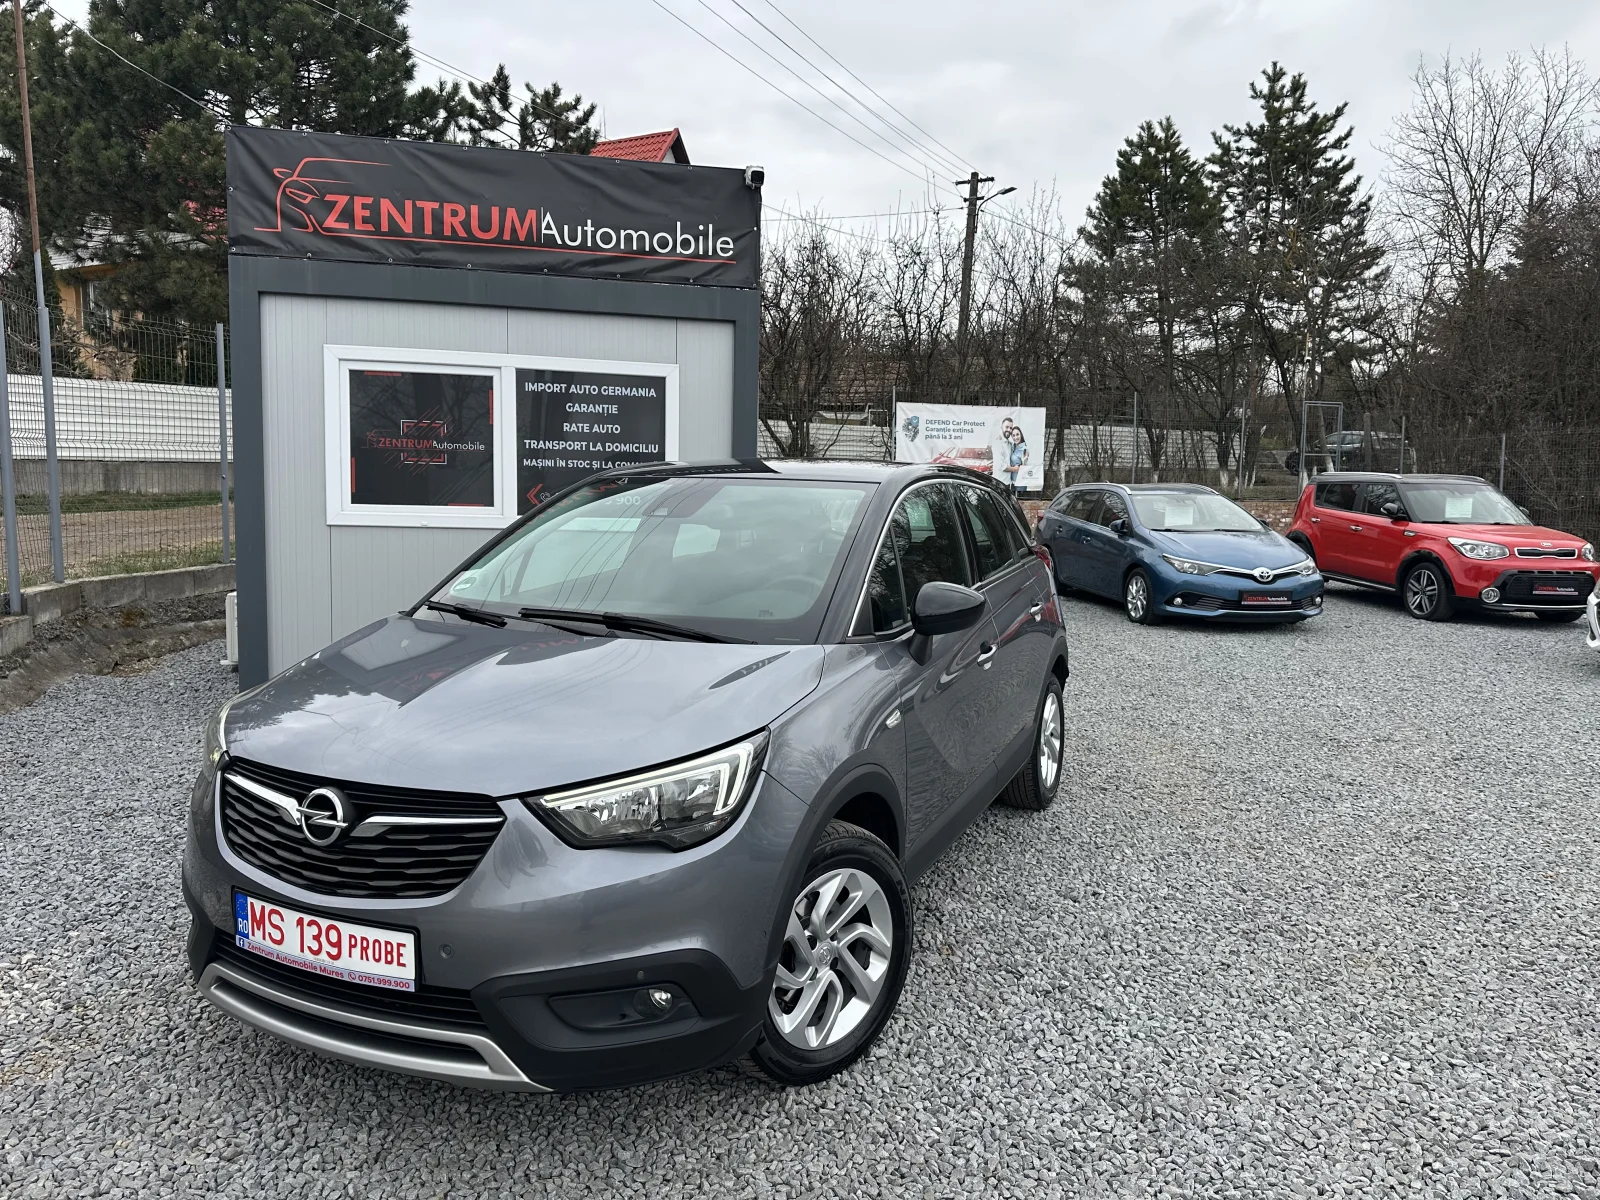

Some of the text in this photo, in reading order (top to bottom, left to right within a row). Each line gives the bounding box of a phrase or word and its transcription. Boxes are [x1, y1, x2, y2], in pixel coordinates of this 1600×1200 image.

[323, 194, 735, 258] ZENTRUM Automobile
[525, 382, 657, 397] IMPORT AUTO GERMANIA
[565, 402, 618, 416] GARANȚIE
[563, 423, 621, 434] RATE AUTO
[379, 438, 485, 451] ZENTRUM Automobile
[524, 440, 659, 453] TRANSPORT LA DOMICILIU
[523, 458, 555, 469] MAȘINI
[556, 457, 566, 468] ÎN
[567, 460, 590, 468] STOC
[592, 460, 600, 470] ȘI
[602, 460, 613, 469] LA
[238, 918, 249, 934] RO
[250, 901, 407, 968] MS 139 PROBE
[247, 942, 275, 959] Zentrum
[275, 953, 318, 971] Automobile
[319, 966, 345, 979] Mures
[358, 974, 411, 990] 0751.999.900
